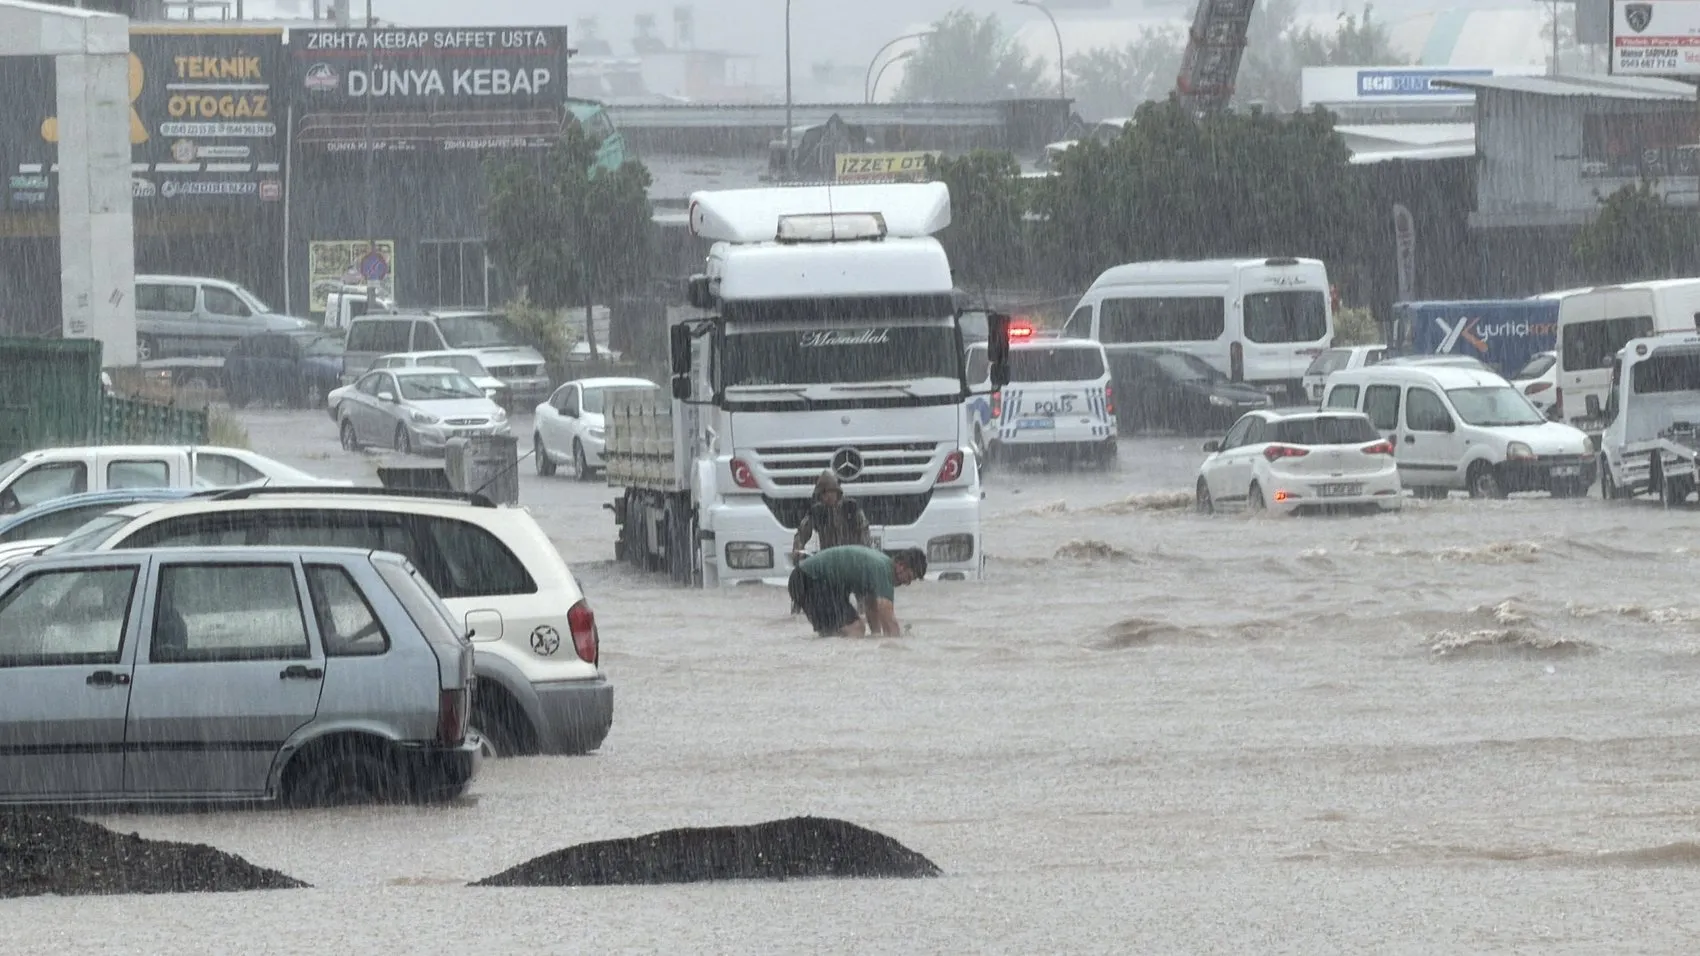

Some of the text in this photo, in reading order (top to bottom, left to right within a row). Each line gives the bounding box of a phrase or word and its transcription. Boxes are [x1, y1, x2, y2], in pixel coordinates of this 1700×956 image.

[308, 31, 547, 49] ZIRHTA KEBAP SAFFET USTA
[174, 50, 261, 78] TEKNİK
[348, 64, 550, 97] DÜNYA KEBAP
[167, 95, 268, 117] OTOGAZ
